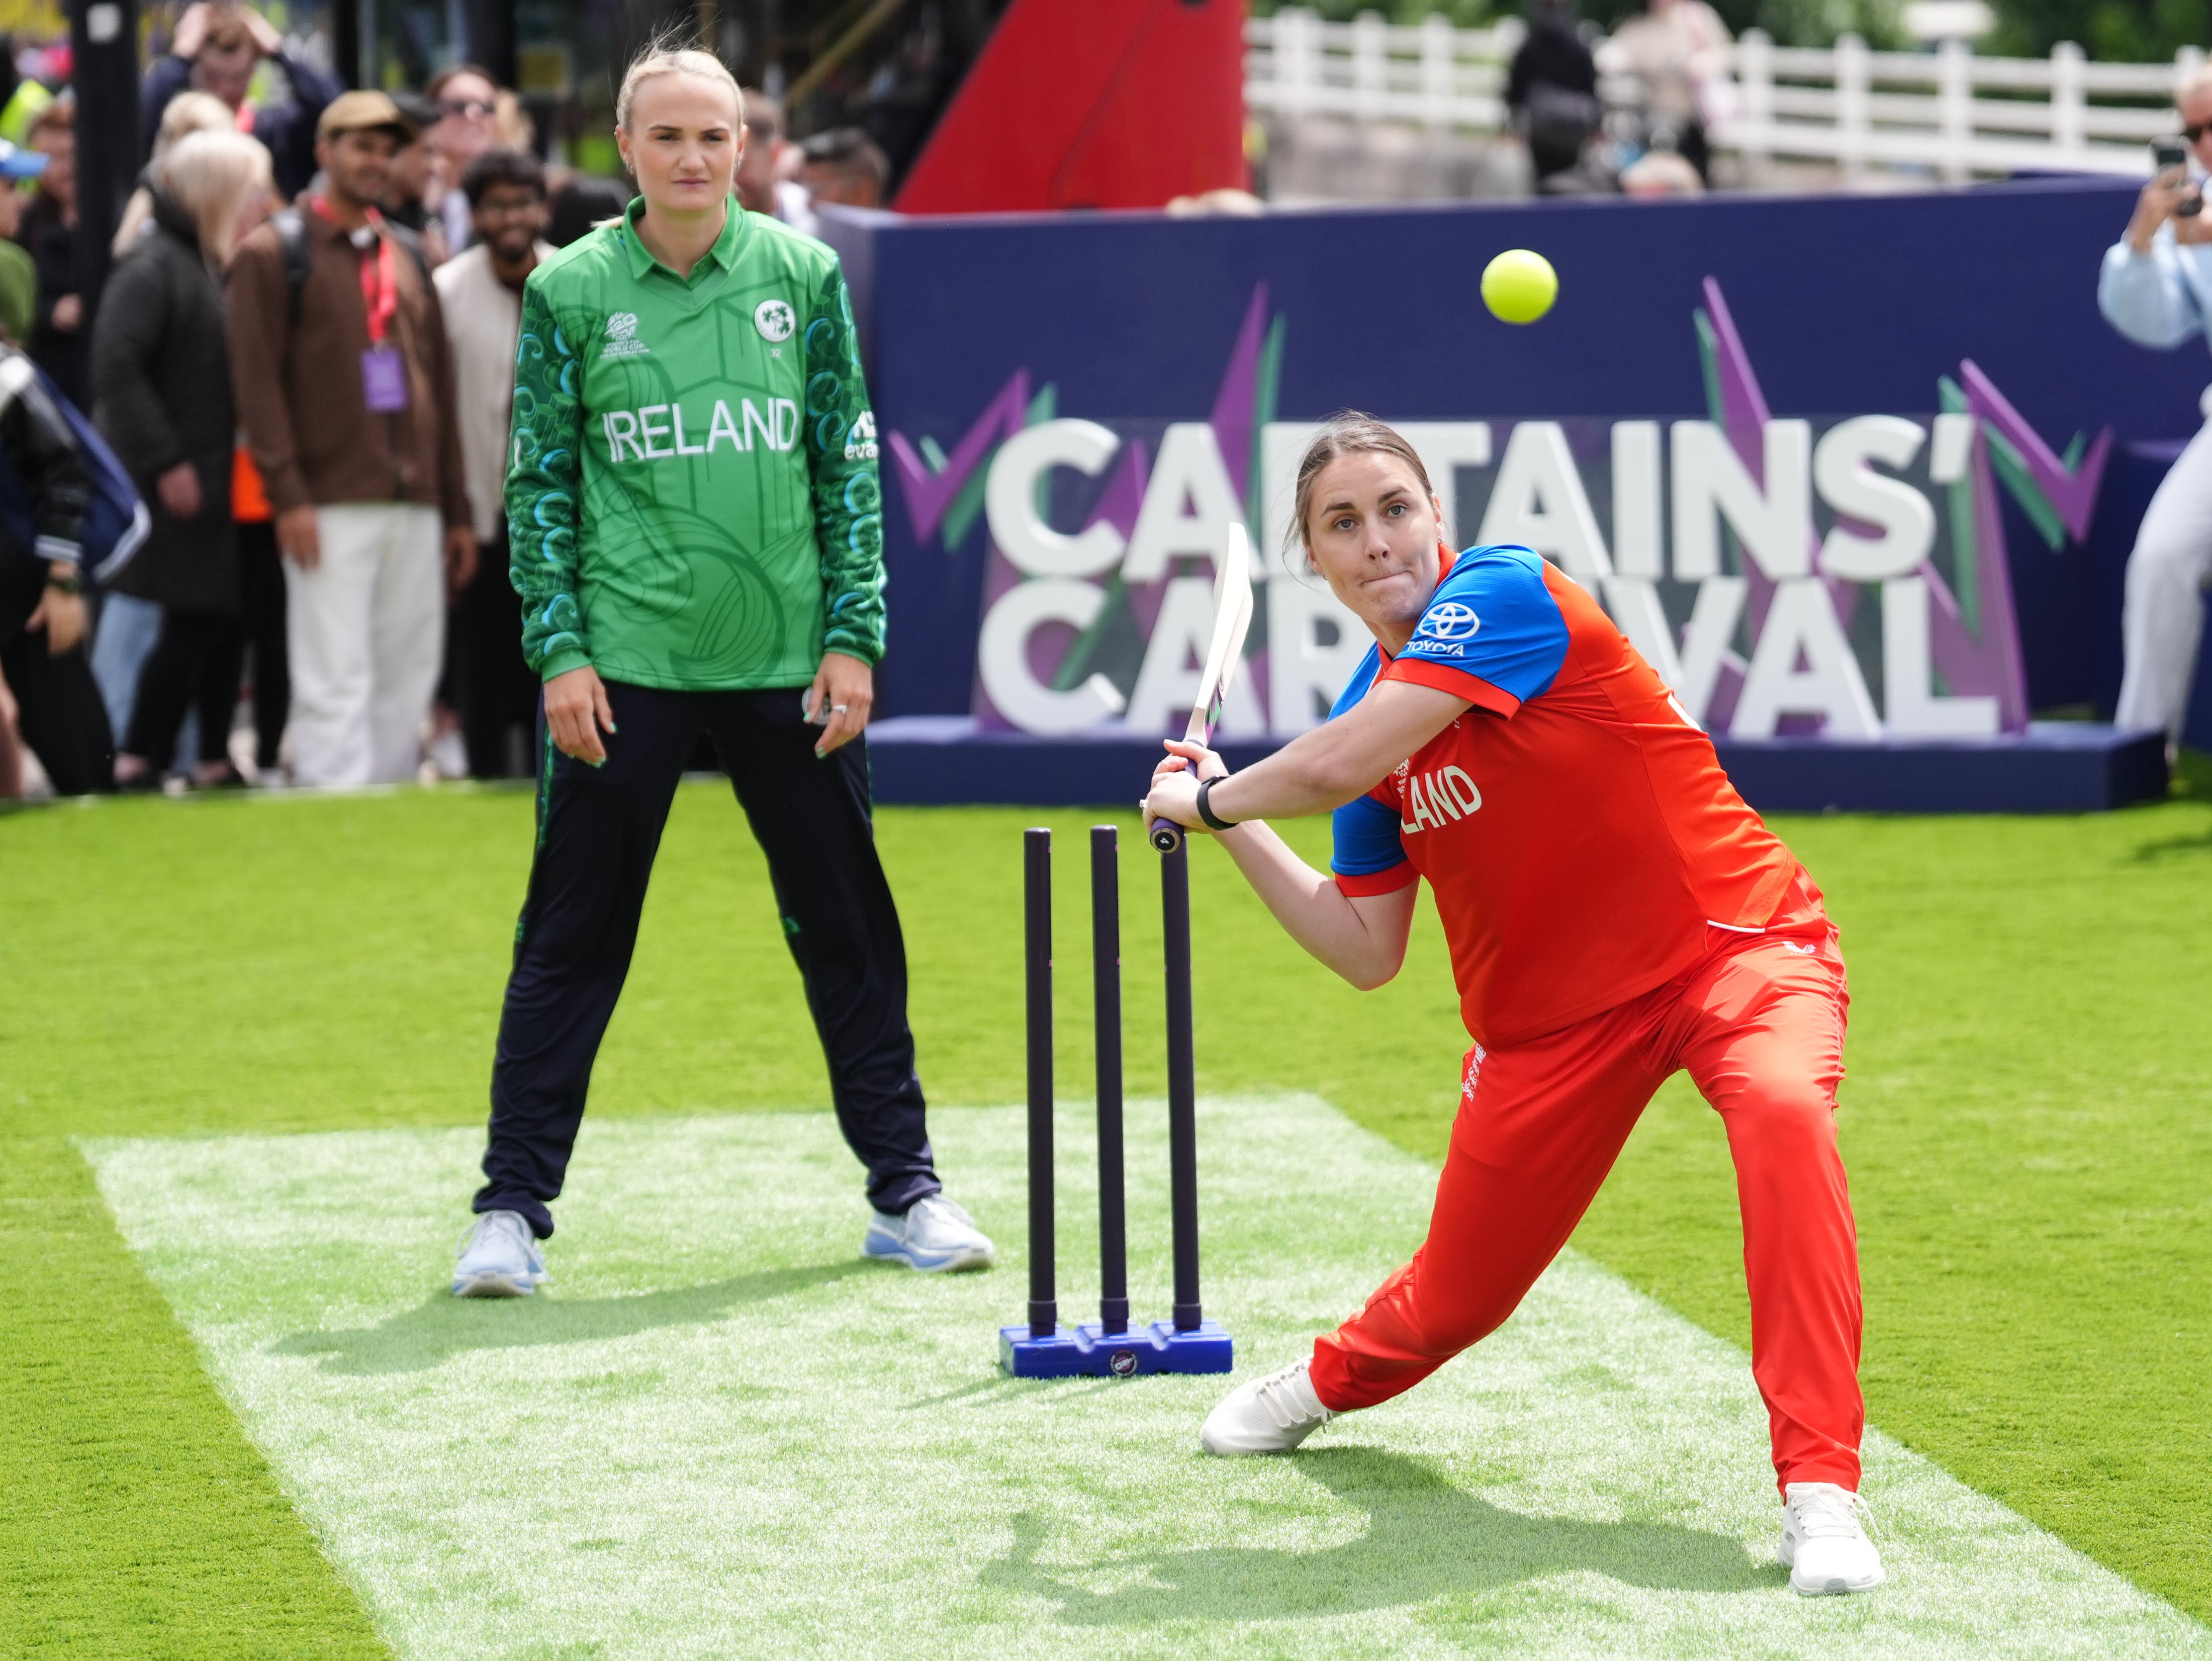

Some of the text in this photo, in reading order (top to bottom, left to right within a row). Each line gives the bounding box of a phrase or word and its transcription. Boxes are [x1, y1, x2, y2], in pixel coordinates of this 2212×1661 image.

[602, 397, 798, 463] IRELAND
[978, 575, 2000, 736] CARVAL
[1406, 639, 1465, 657] TOYOTA
